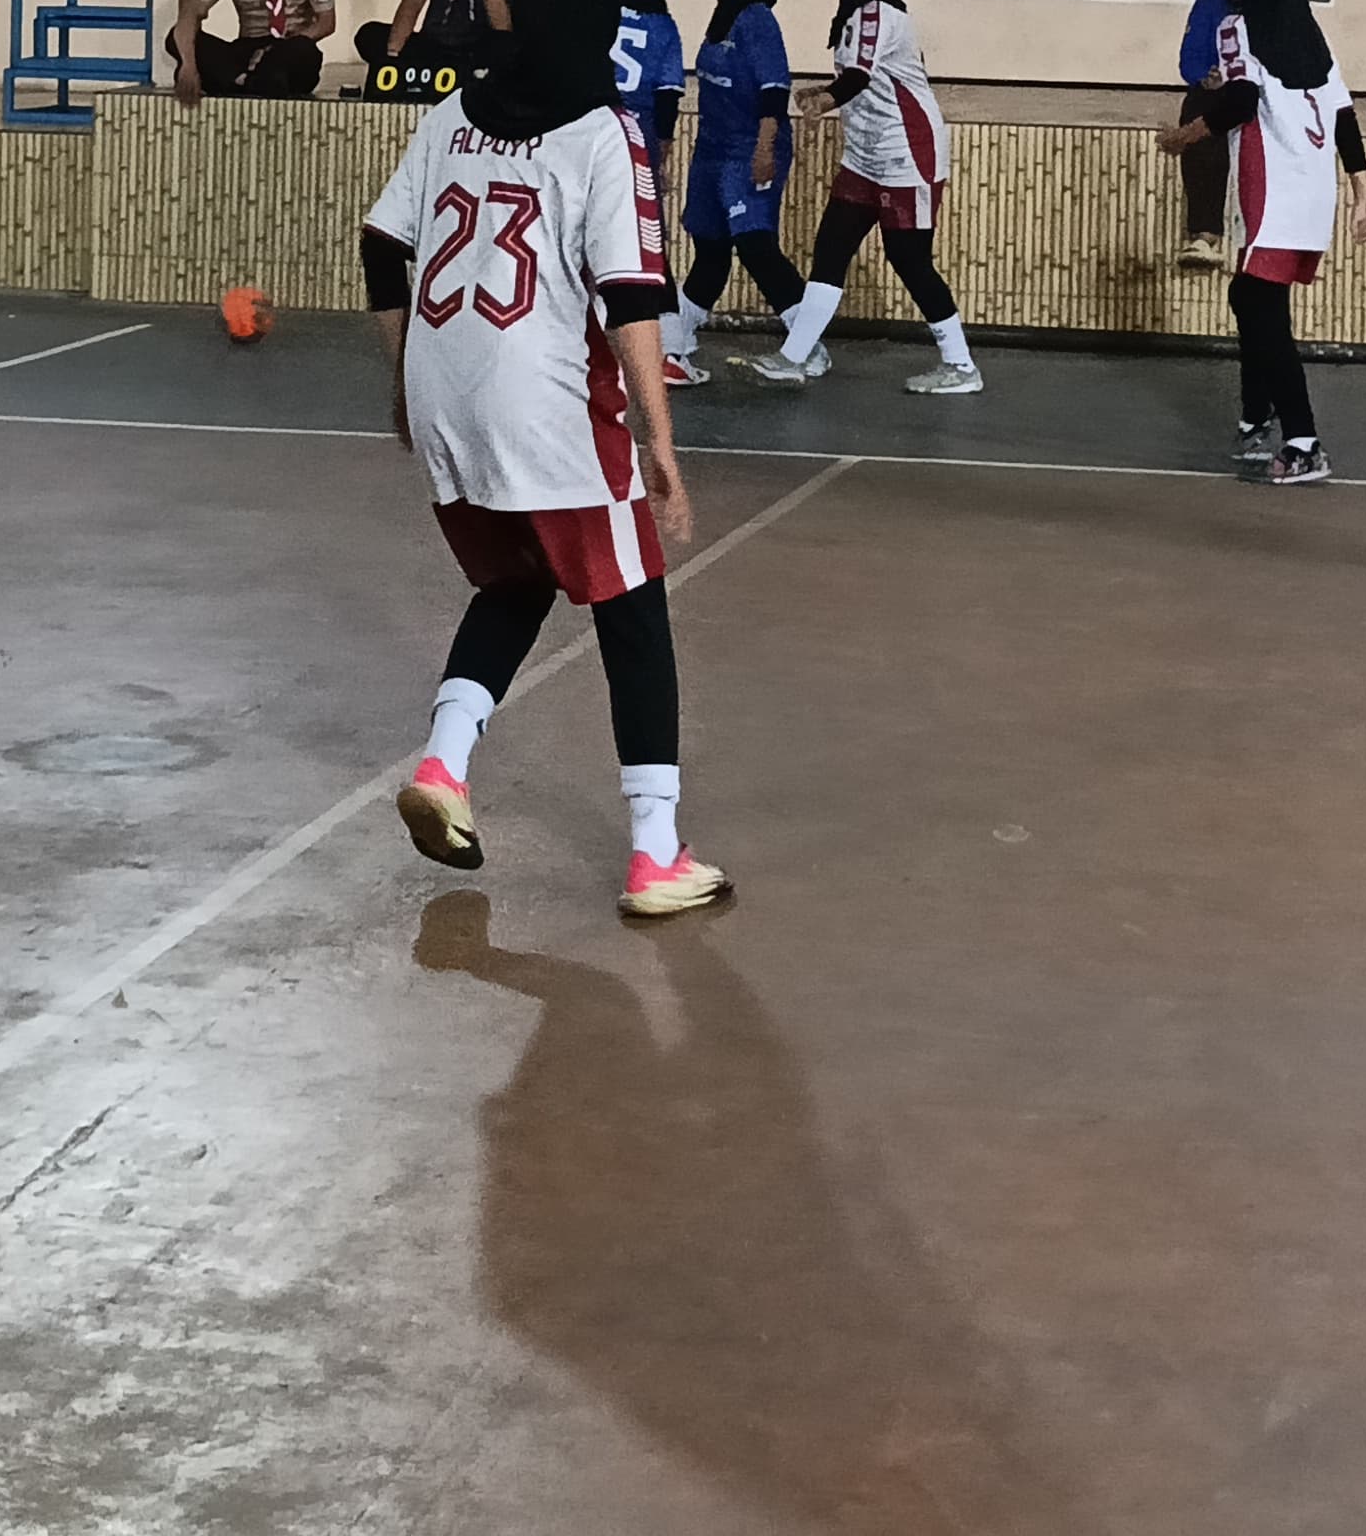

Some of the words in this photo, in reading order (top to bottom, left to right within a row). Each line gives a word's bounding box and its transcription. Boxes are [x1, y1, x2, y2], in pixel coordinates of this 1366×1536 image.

[376, 66, 398, 91] 0
[435, 67, 456, 93] 0
[417, 181, 541, 331] 23
